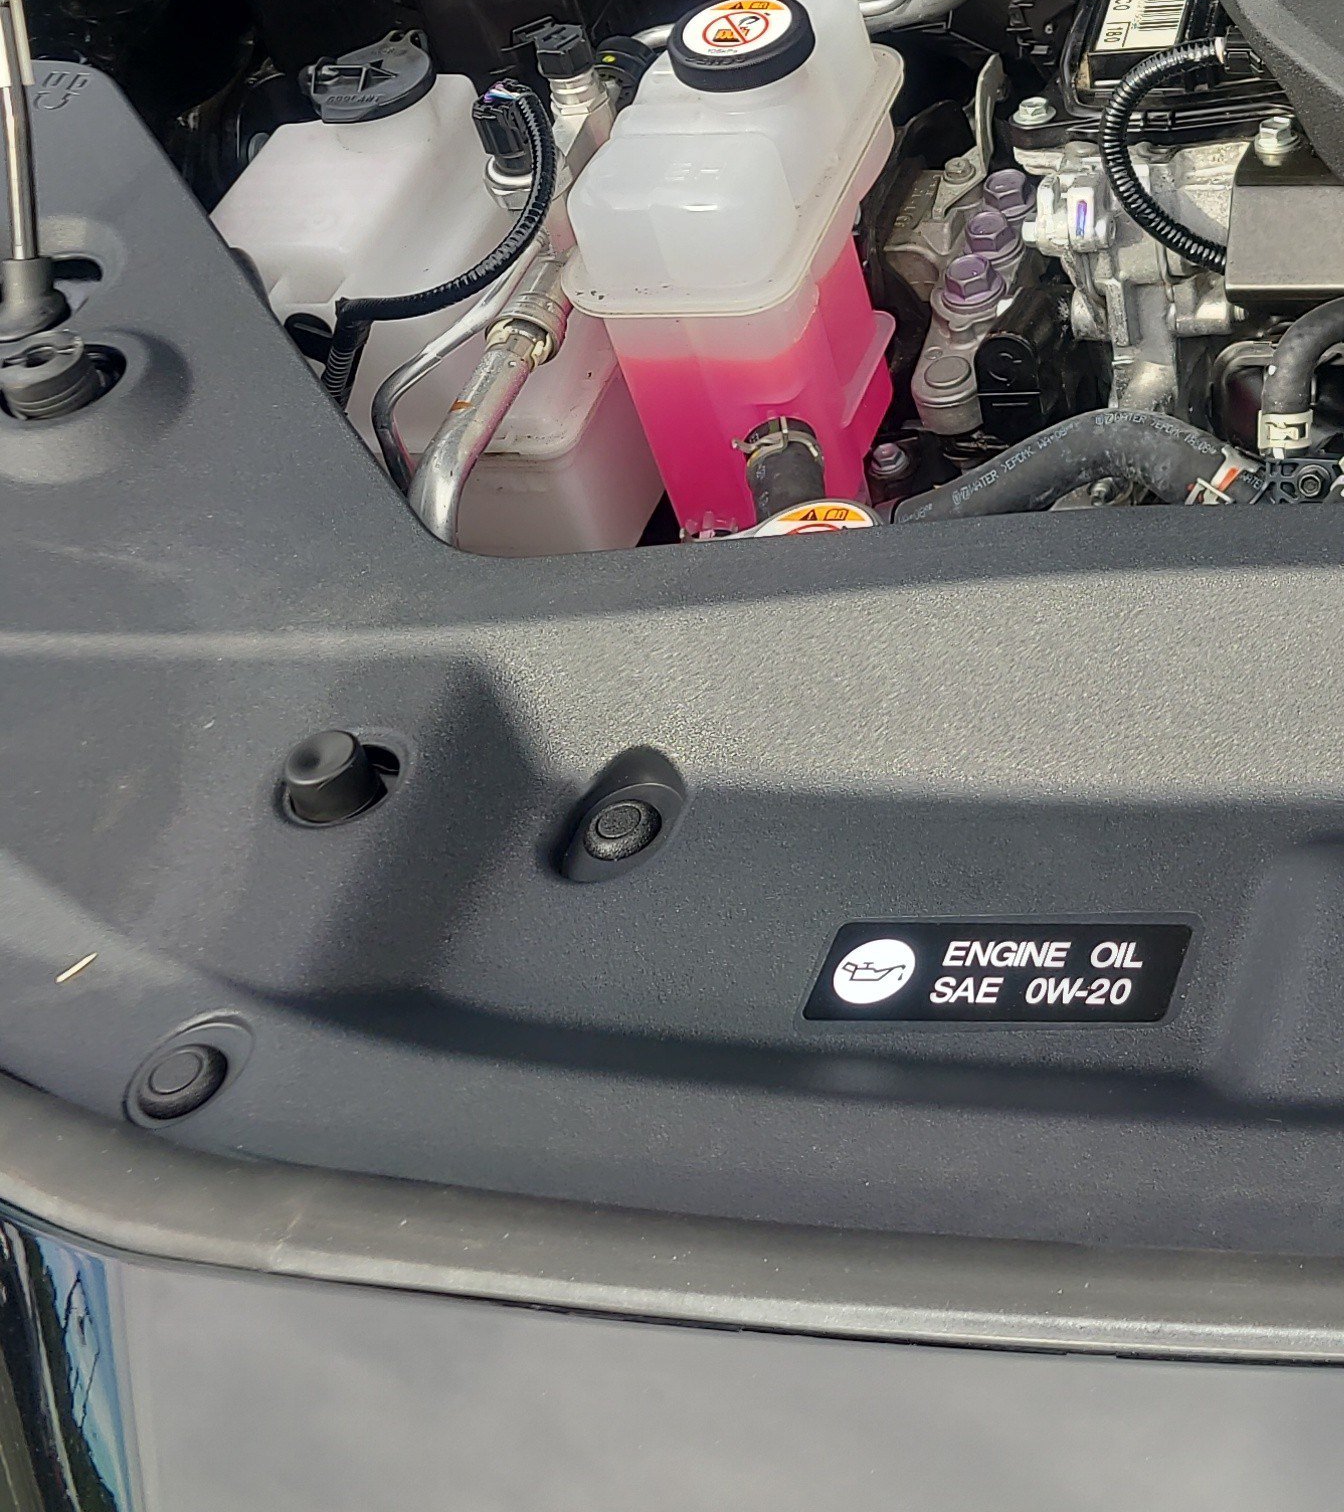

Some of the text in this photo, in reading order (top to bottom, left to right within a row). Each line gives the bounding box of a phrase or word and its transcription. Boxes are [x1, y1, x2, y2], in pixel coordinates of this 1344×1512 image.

[1104, 26, 1124, 43] 180
[942, 941, 1143, 968] ENGINE OIL
[930, 977, 1133, 1005] SAE 0W-20
